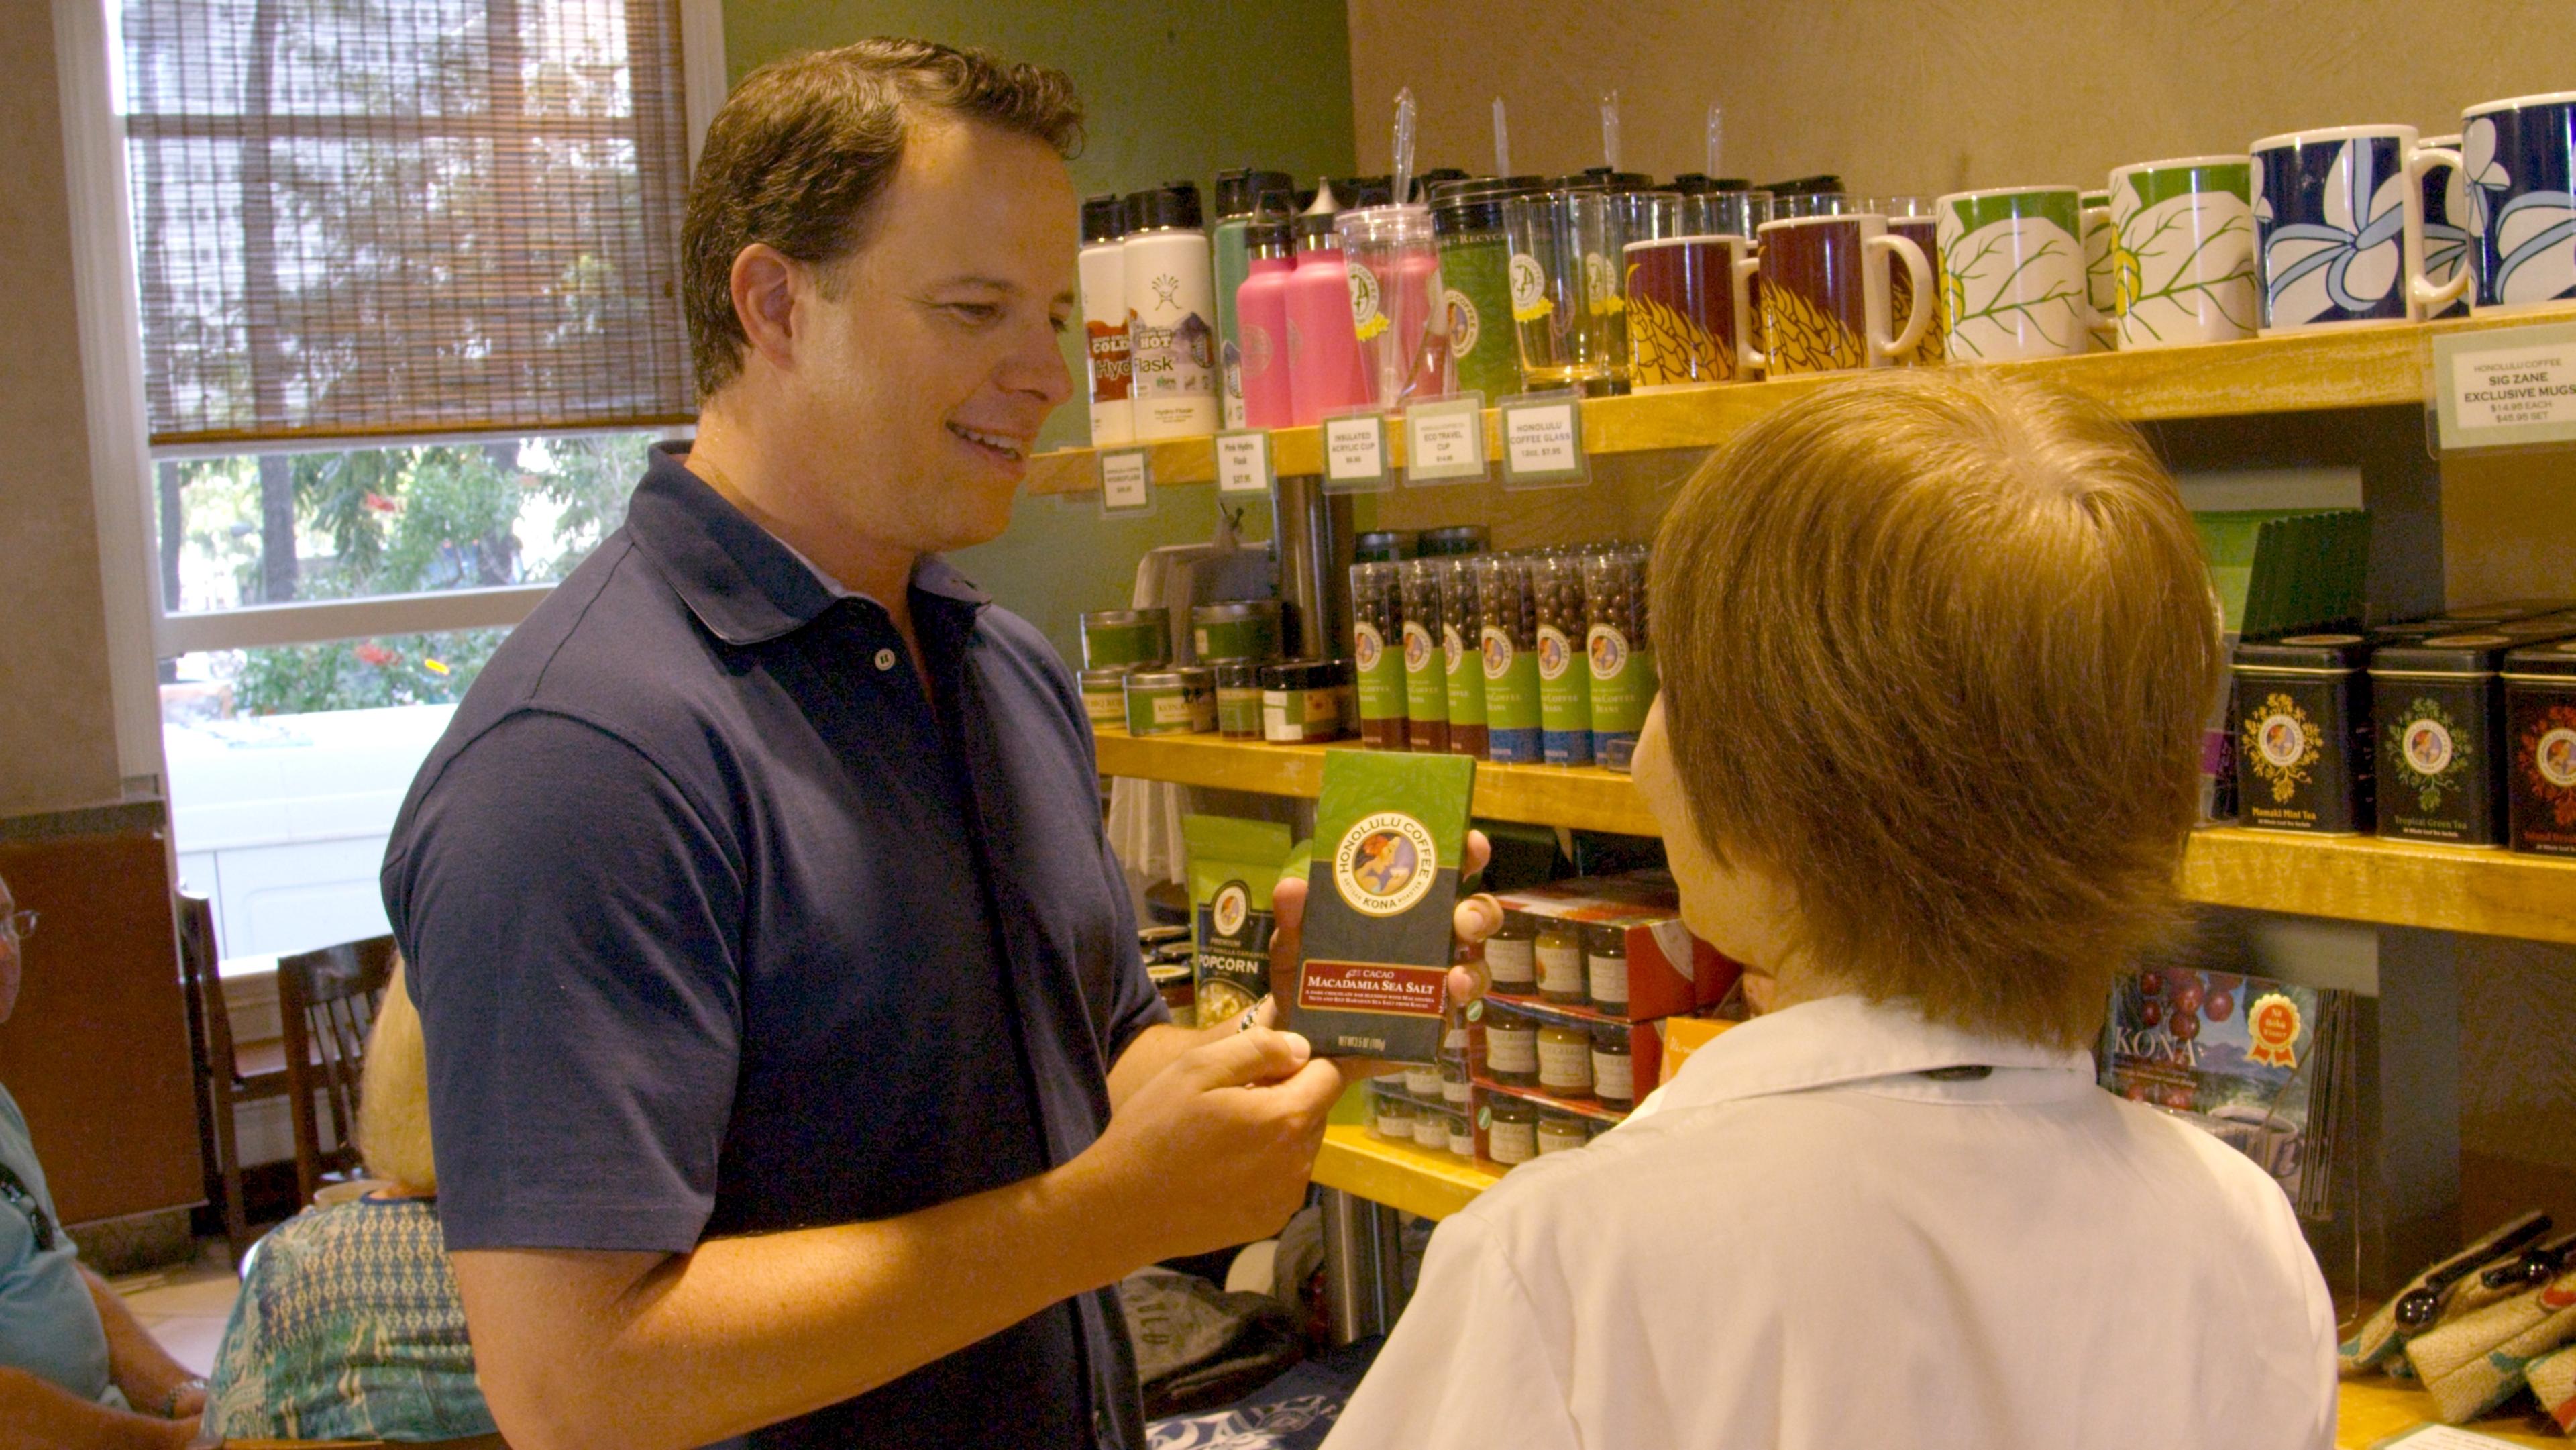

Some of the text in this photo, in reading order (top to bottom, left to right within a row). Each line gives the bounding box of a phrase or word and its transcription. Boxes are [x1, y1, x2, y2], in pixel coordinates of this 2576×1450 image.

[1093, 340, 1130, 354] COLD
[1141, 337, 1171, 349] HOT
[2473, 358, 2562, 372] HONOLULU COFFEE
[2489, 372, 2548, 386] SIG ZANE
[2464, 384, 2576, 403] EXCLUSIVE MUGS
[2525, 401, 2553, 411] EACH
[2530, 411, 2549, 421] SET
[1517, 421, 1562, 433] HONOLULU
[1334, 431, 1372, 442] INSULATED
[1424, 431, 1464, 442] ECO TRAVEL
[1510, 433, 1570, 444] COFFEE GLASS
[1332, 442, 1375, 452] ACRYLIC CUP
[1437, 442, 1451, 452] CUP
[2394, 815, 2468, 831] Tropical Green Tea
[1340, 817, 1432, 879] HONOLULU COFFEE
[1362, 897, 1397, 909] KONA
[1199, 953, 1259, 974] POPCORN
[1362, 969, 1395, 979] CACAO
[1307, 976, 1435, 995] MACADAMIA SEA SALT
[2114, 1026, 2198, 1068] KONA
